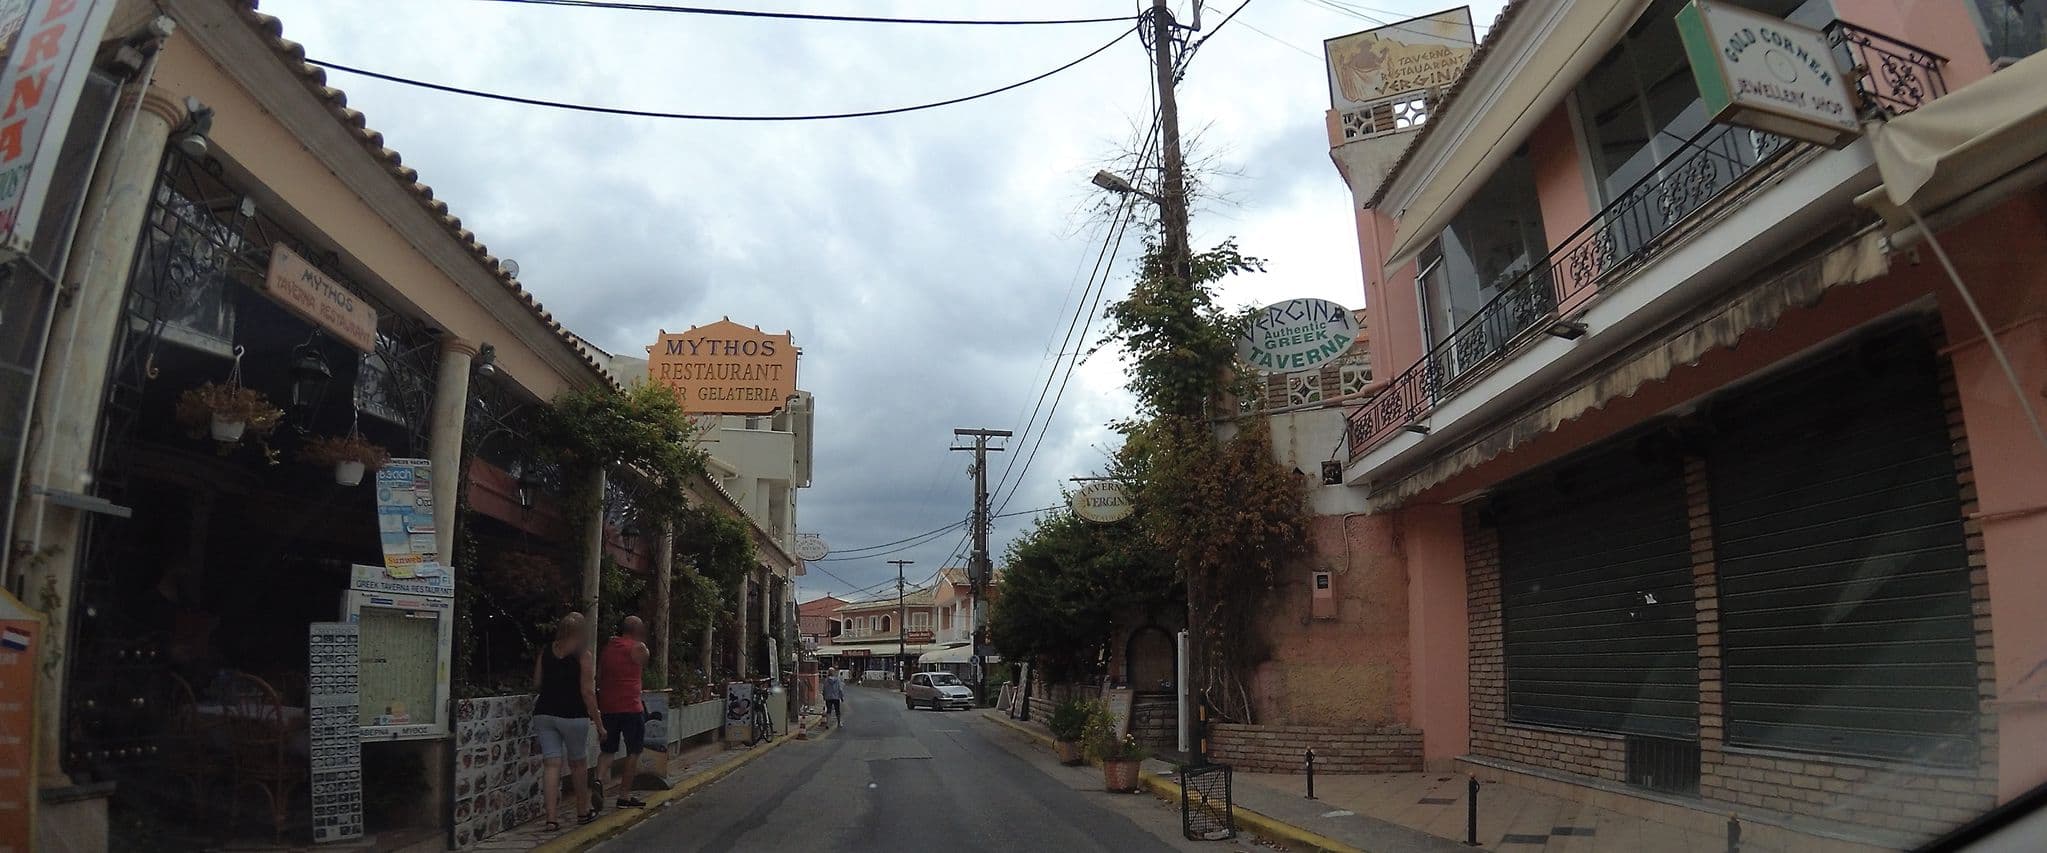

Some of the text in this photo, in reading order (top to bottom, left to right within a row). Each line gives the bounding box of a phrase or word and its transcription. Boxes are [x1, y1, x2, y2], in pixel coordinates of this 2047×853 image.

[1400, 49, 1454, 66] TAVERNA
[1724, 28, 1832, 87] GOLD CORNER
[1737, 78, 1844, 115] JEWELLERY SHOP
[301, 268, 354, 313] MYTHOS
[276, 276, 371, 346] TAVERNA RESTAURANT
[1241, 299, 1349, 343] VERGINA
[1264, 321, 1327, 340] Authentic
[1264, 330, 1328, 350] GREEK
[665, 336, 776, 357] MYTHOS
[1248, 333, 1351, 369] TAVERNA
[659, 363, 783, 382] RESTAURANT
[698, 387, 778, 401] GELATERIA
[1081, 482, 1122, 497] TAVERN
[356, 579, 379, 590] GREEK
[381, 581, 410, 592] TAVERNA
